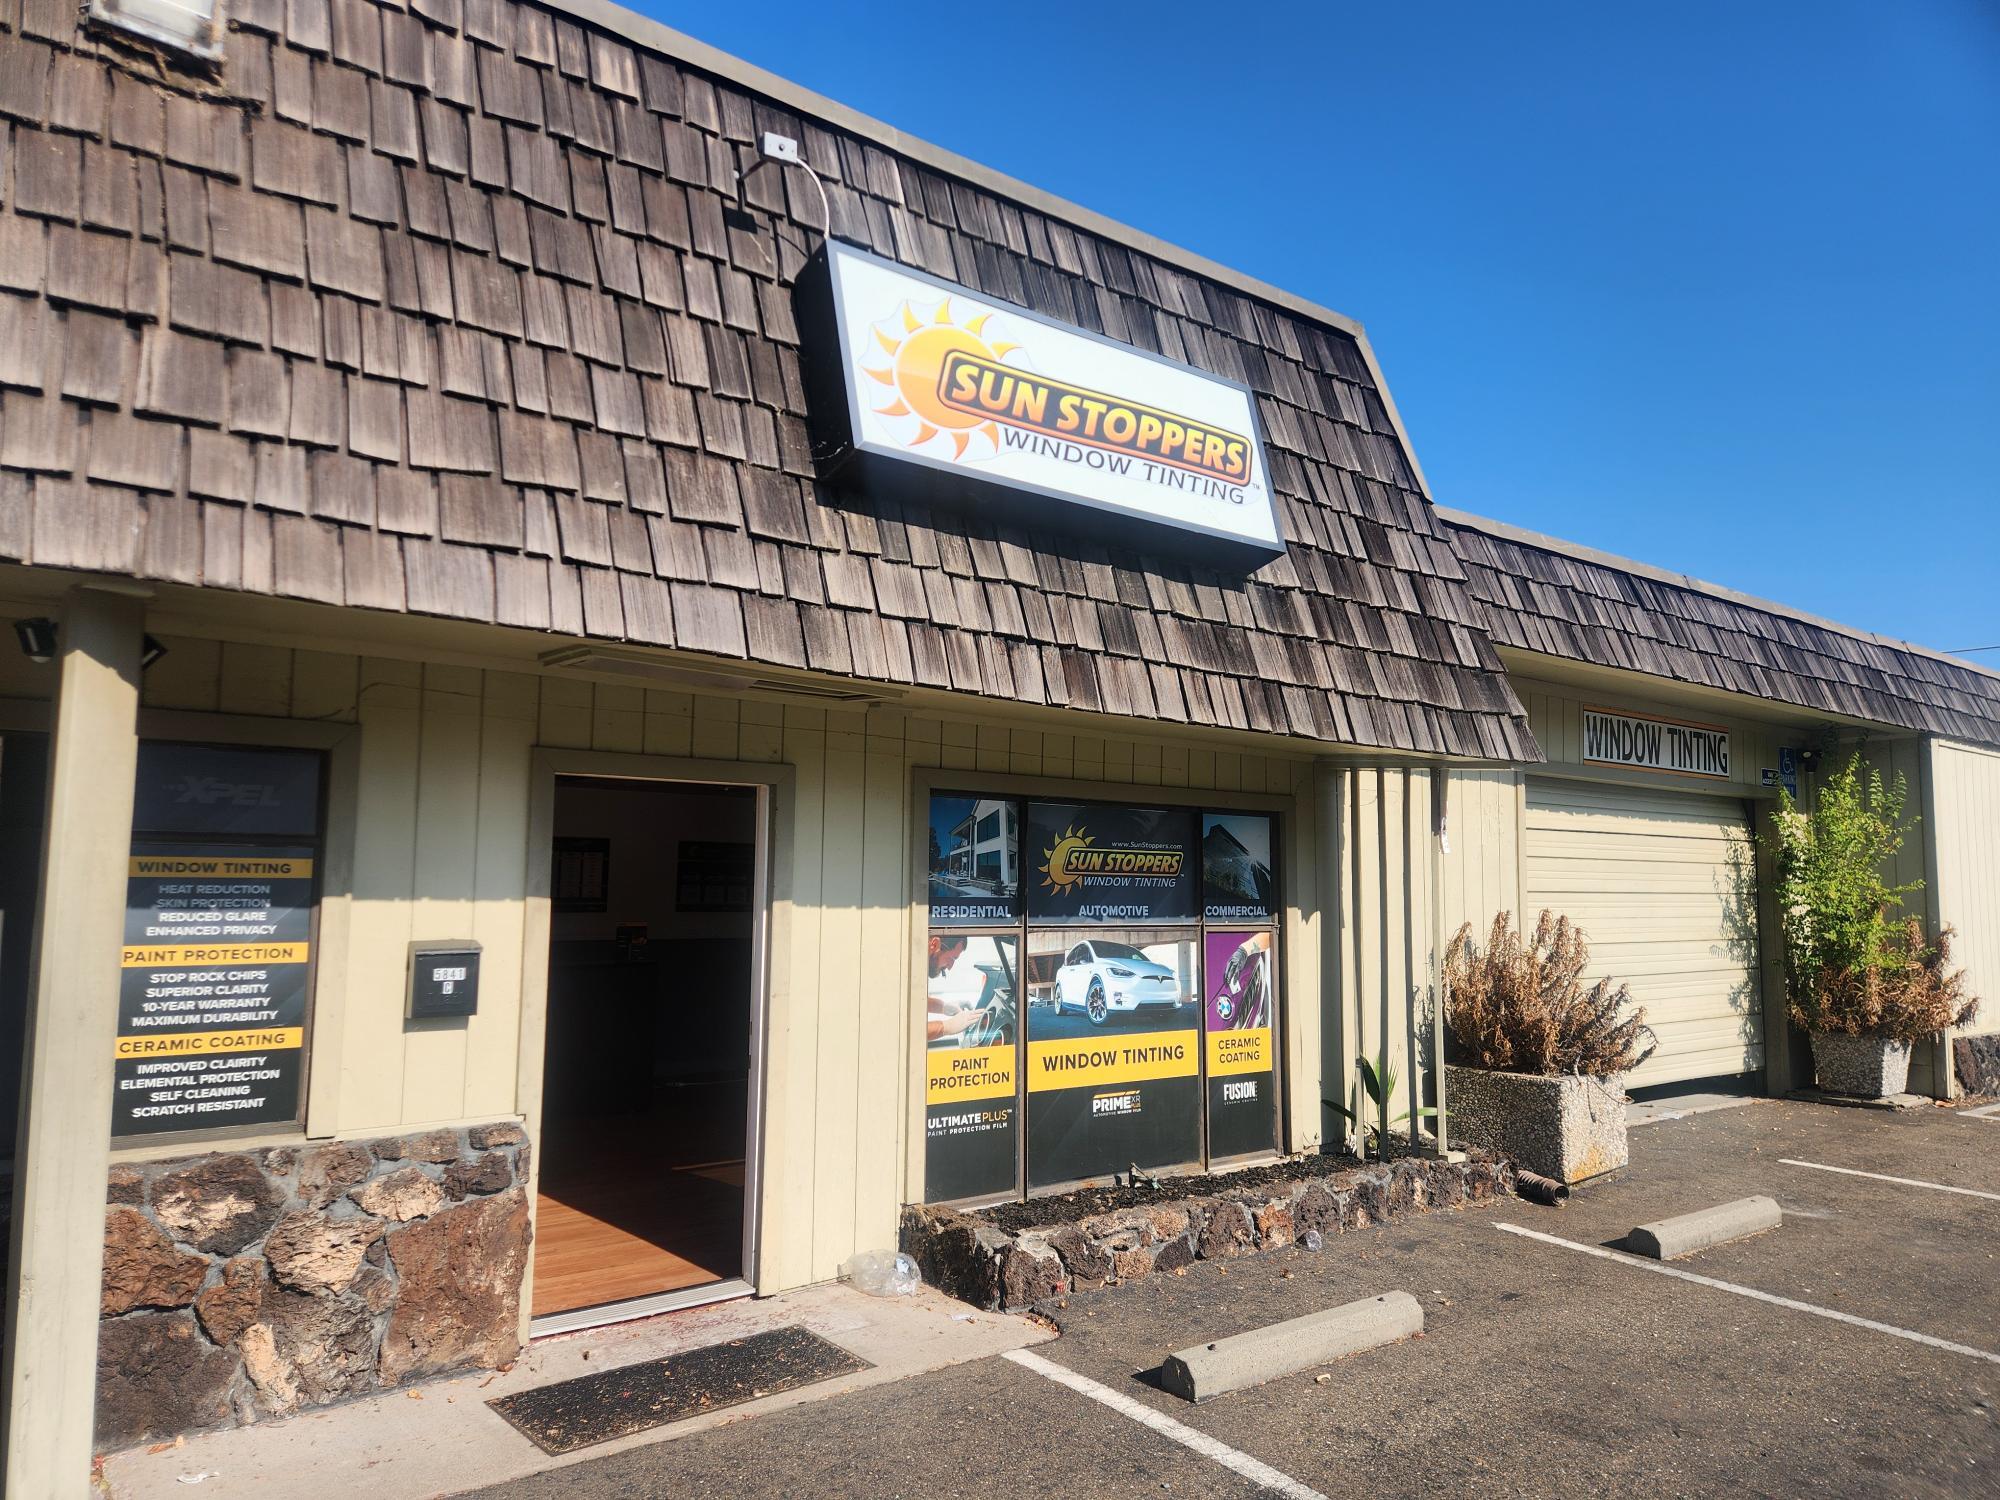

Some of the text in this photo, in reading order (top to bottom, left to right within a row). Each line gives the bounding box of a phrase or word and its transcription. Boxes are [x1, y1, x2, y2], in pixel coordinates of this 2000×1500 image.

[953, 364, 1243, 475] SUN STOPPERS
[1003, 427, 1245, 505] WINDOW TINTING
[1585, 714, 1728, 774] WINDOW TINTING
[172, 776, 281, 806] XPEL
[1111, 841, 1182, 850] www.SunStoppers.com
[138, 861, 291, 874] WINDOW TINTING
[1068, 852, 1180, 873] SUN STOPPERS
[1084, 876, 1176, 887] WINDOW TINTING
[159, 885, 270, 894] HEAT REDUCTION
[156, 899, 271, 908] SKIN PROTECTION
[1078, 905, 1149, 917] AUTOMOTIVE
[1205, 905, 1268, 917] COMMERCIAL
[159, 912, 267, 922] REDUCED GLARE
[932, 905, 1012, 918] RESIDENTIAL
[146, 925, 277, 936] ENHANCED PRIVACY
[124, 948, 293, 962] PAINT PROTECTION
[150, 970, 267, 984] STOP ROCK CHIPS
[146, 984, 269, 998] SUPERIOR CLARITY
[142, 997, 271, 1012] 10-YEAR WARRANTY
[132, 1010, 279, 1027] MAXIMUM DURABILITY
[119, 1033, 286, 1054] CERAMIC COATING
[1218, 1037, 1261, 1050] CERAMIC
[952, 1057, 990, 1072] PAINT
[1043, 1045, 1185, 1072] WINDOW TINTING
[1219, 1051, 1260, 1064] COATING
[137, 1056, 268, 1075] IMPROVED CLAIRITY
[120, 1069, 281, 1090] ELEMENTAL PROTECTION
[930, 1072, 1010, 1090] PROTECTION
[150, 1085, 251, 1102] SELF CLEANING
[1223, 1081, 1256, 1101] FUSION
[132, 1097, 266, 1118] SCRATCH RESISTANT
[1092, 1096, 1131, 1113] PRIME
[950, 1124, 991, 1135] PROTECTION
